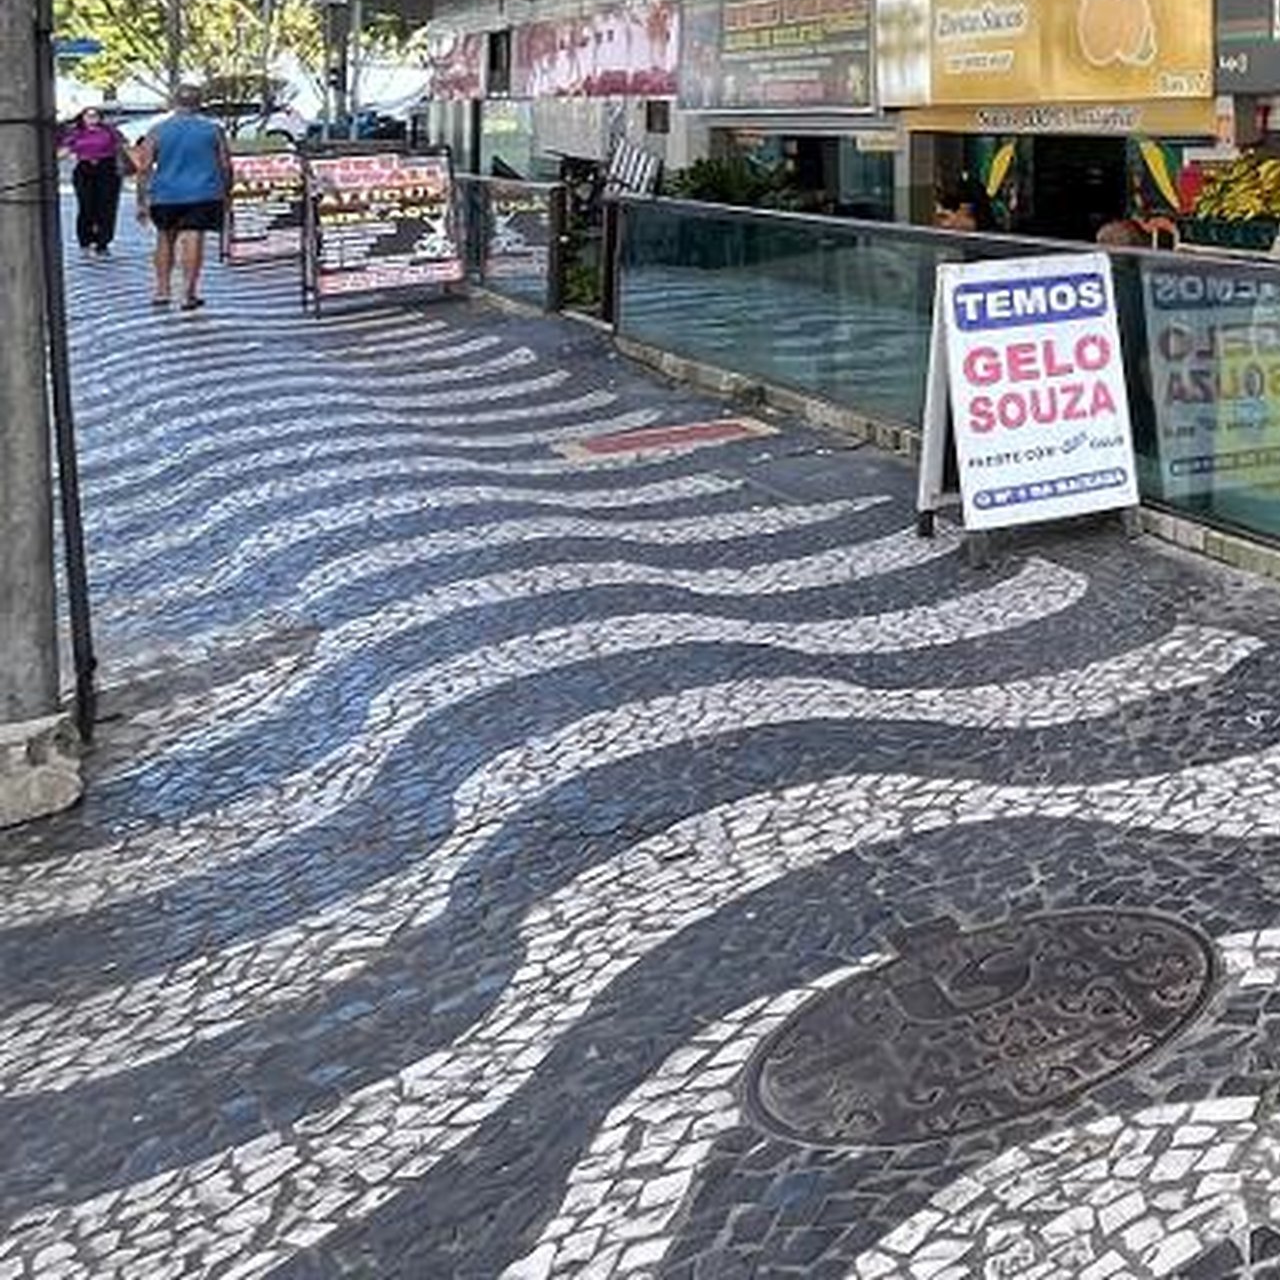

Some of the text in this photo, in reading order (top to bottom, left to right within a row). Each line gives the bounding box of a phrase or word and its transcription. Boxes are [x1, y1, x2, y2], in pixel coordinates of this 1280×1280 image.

[956, 281, 1102, 321] TEMOS
[963, 333, 1111, 387] GELO
[969, 380, 1117, 434] SOUZA
